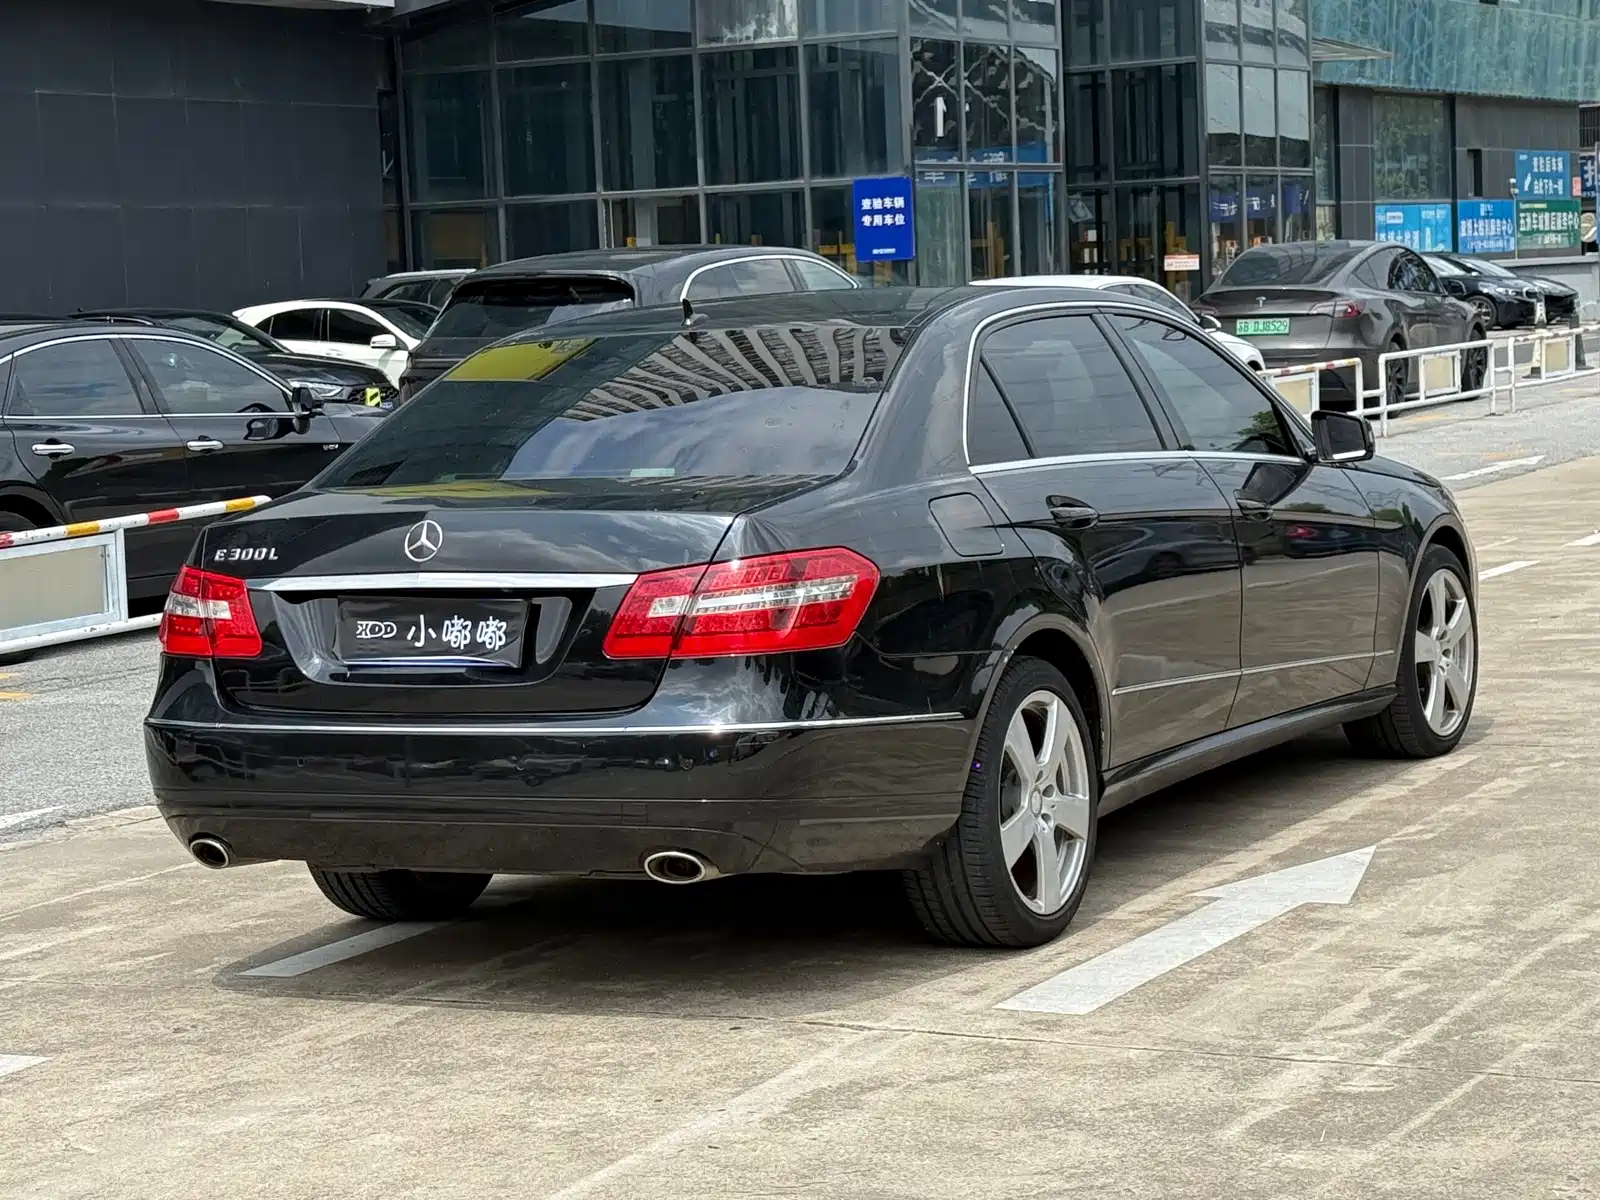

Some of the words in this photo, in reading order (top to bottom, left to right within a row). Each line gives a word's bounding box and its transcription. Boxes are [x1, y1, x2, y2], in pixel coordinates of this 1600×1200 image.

[861, 196, 905, 210] 查验车辆
[861, 213, 906, 227] 专用车位
[406, 614, 507, 650] 小嘟嘟
